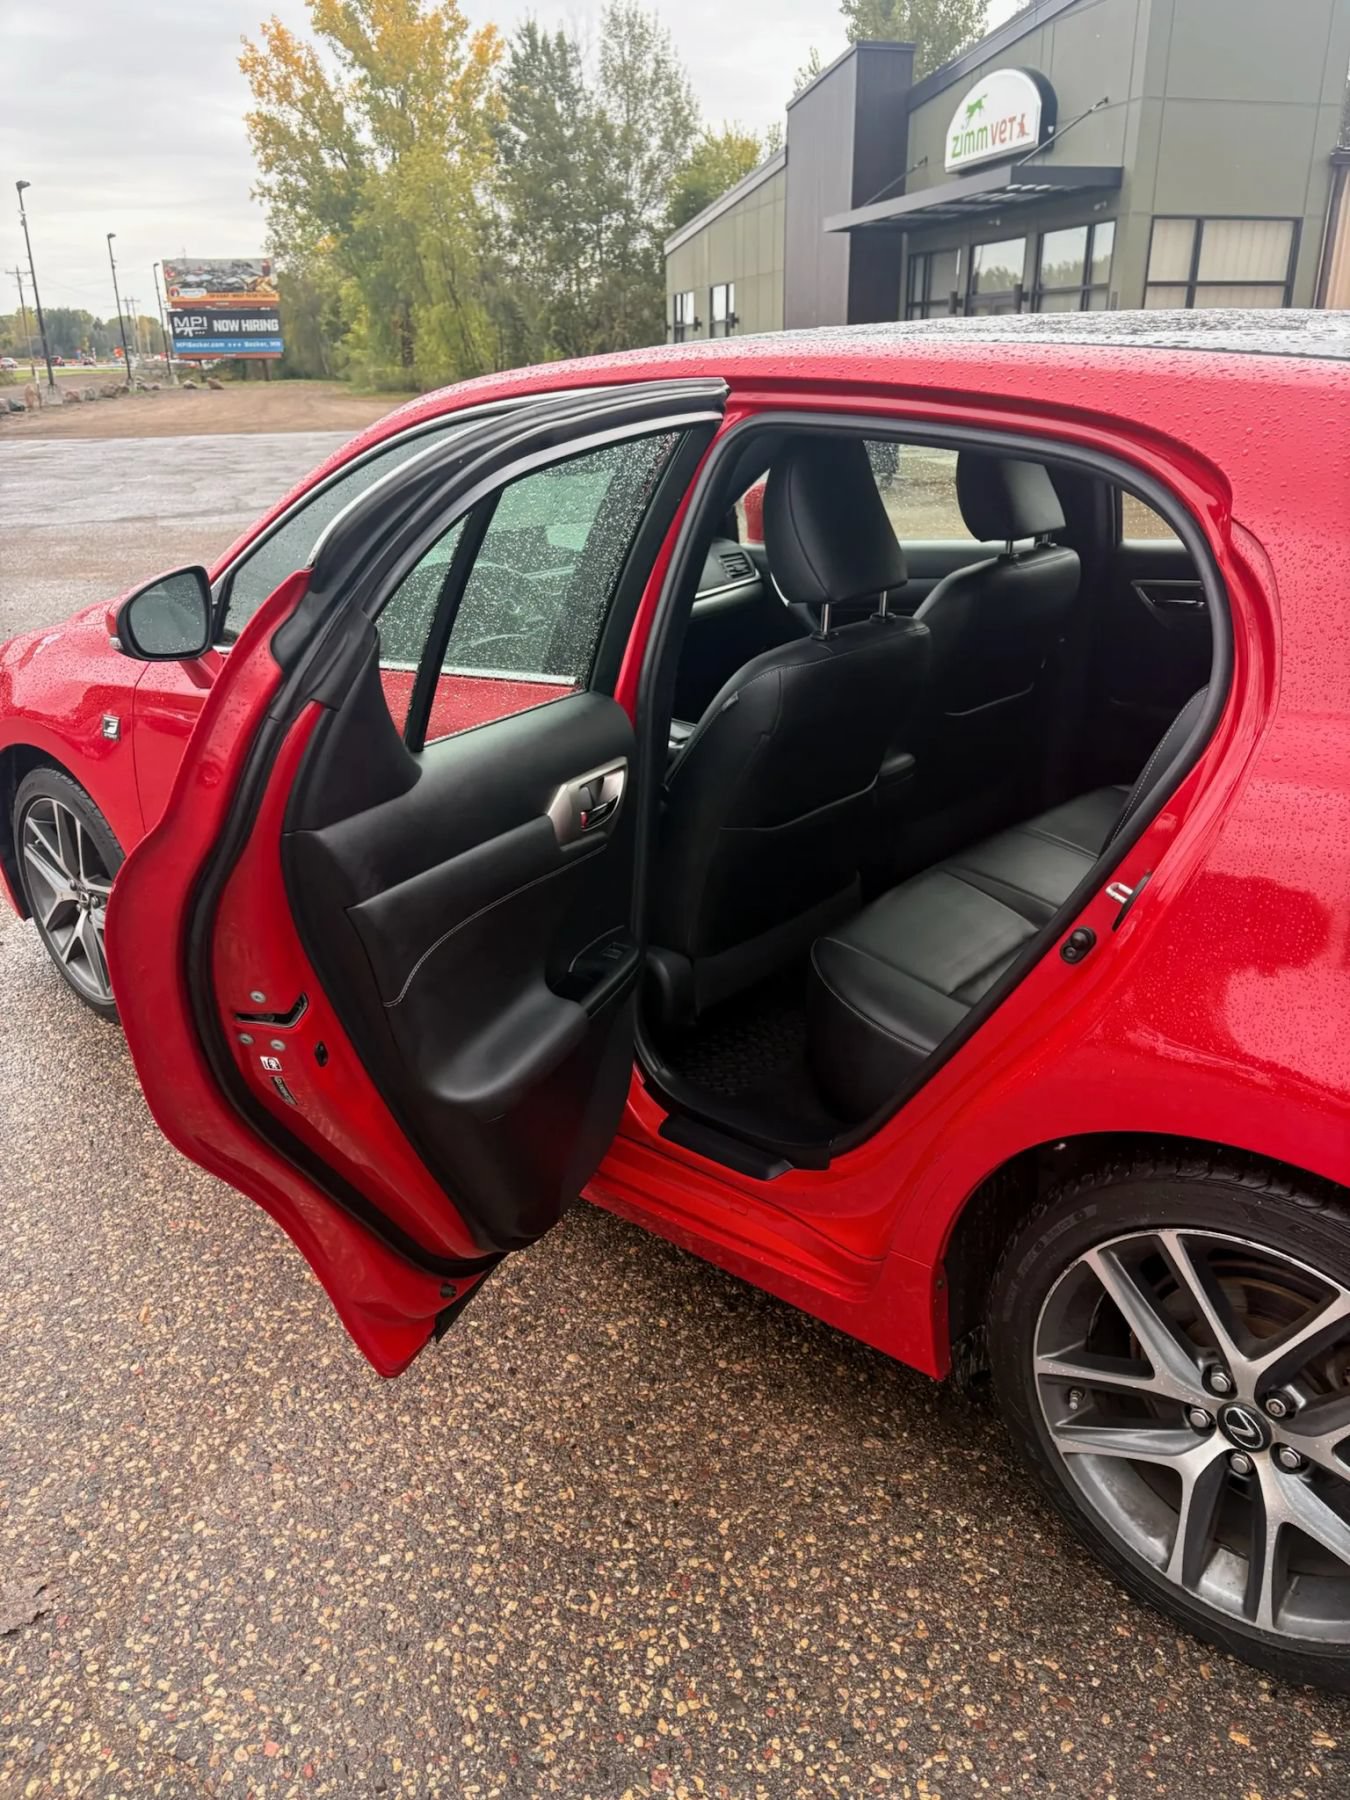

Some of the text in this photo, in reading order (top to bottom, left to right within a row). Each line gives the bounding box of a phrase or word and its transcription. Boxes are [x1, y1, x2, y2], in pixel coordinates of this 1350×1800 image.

[173, 316, 208, 327] MPI
[213, 319, 279, 332] NOW HIRING
